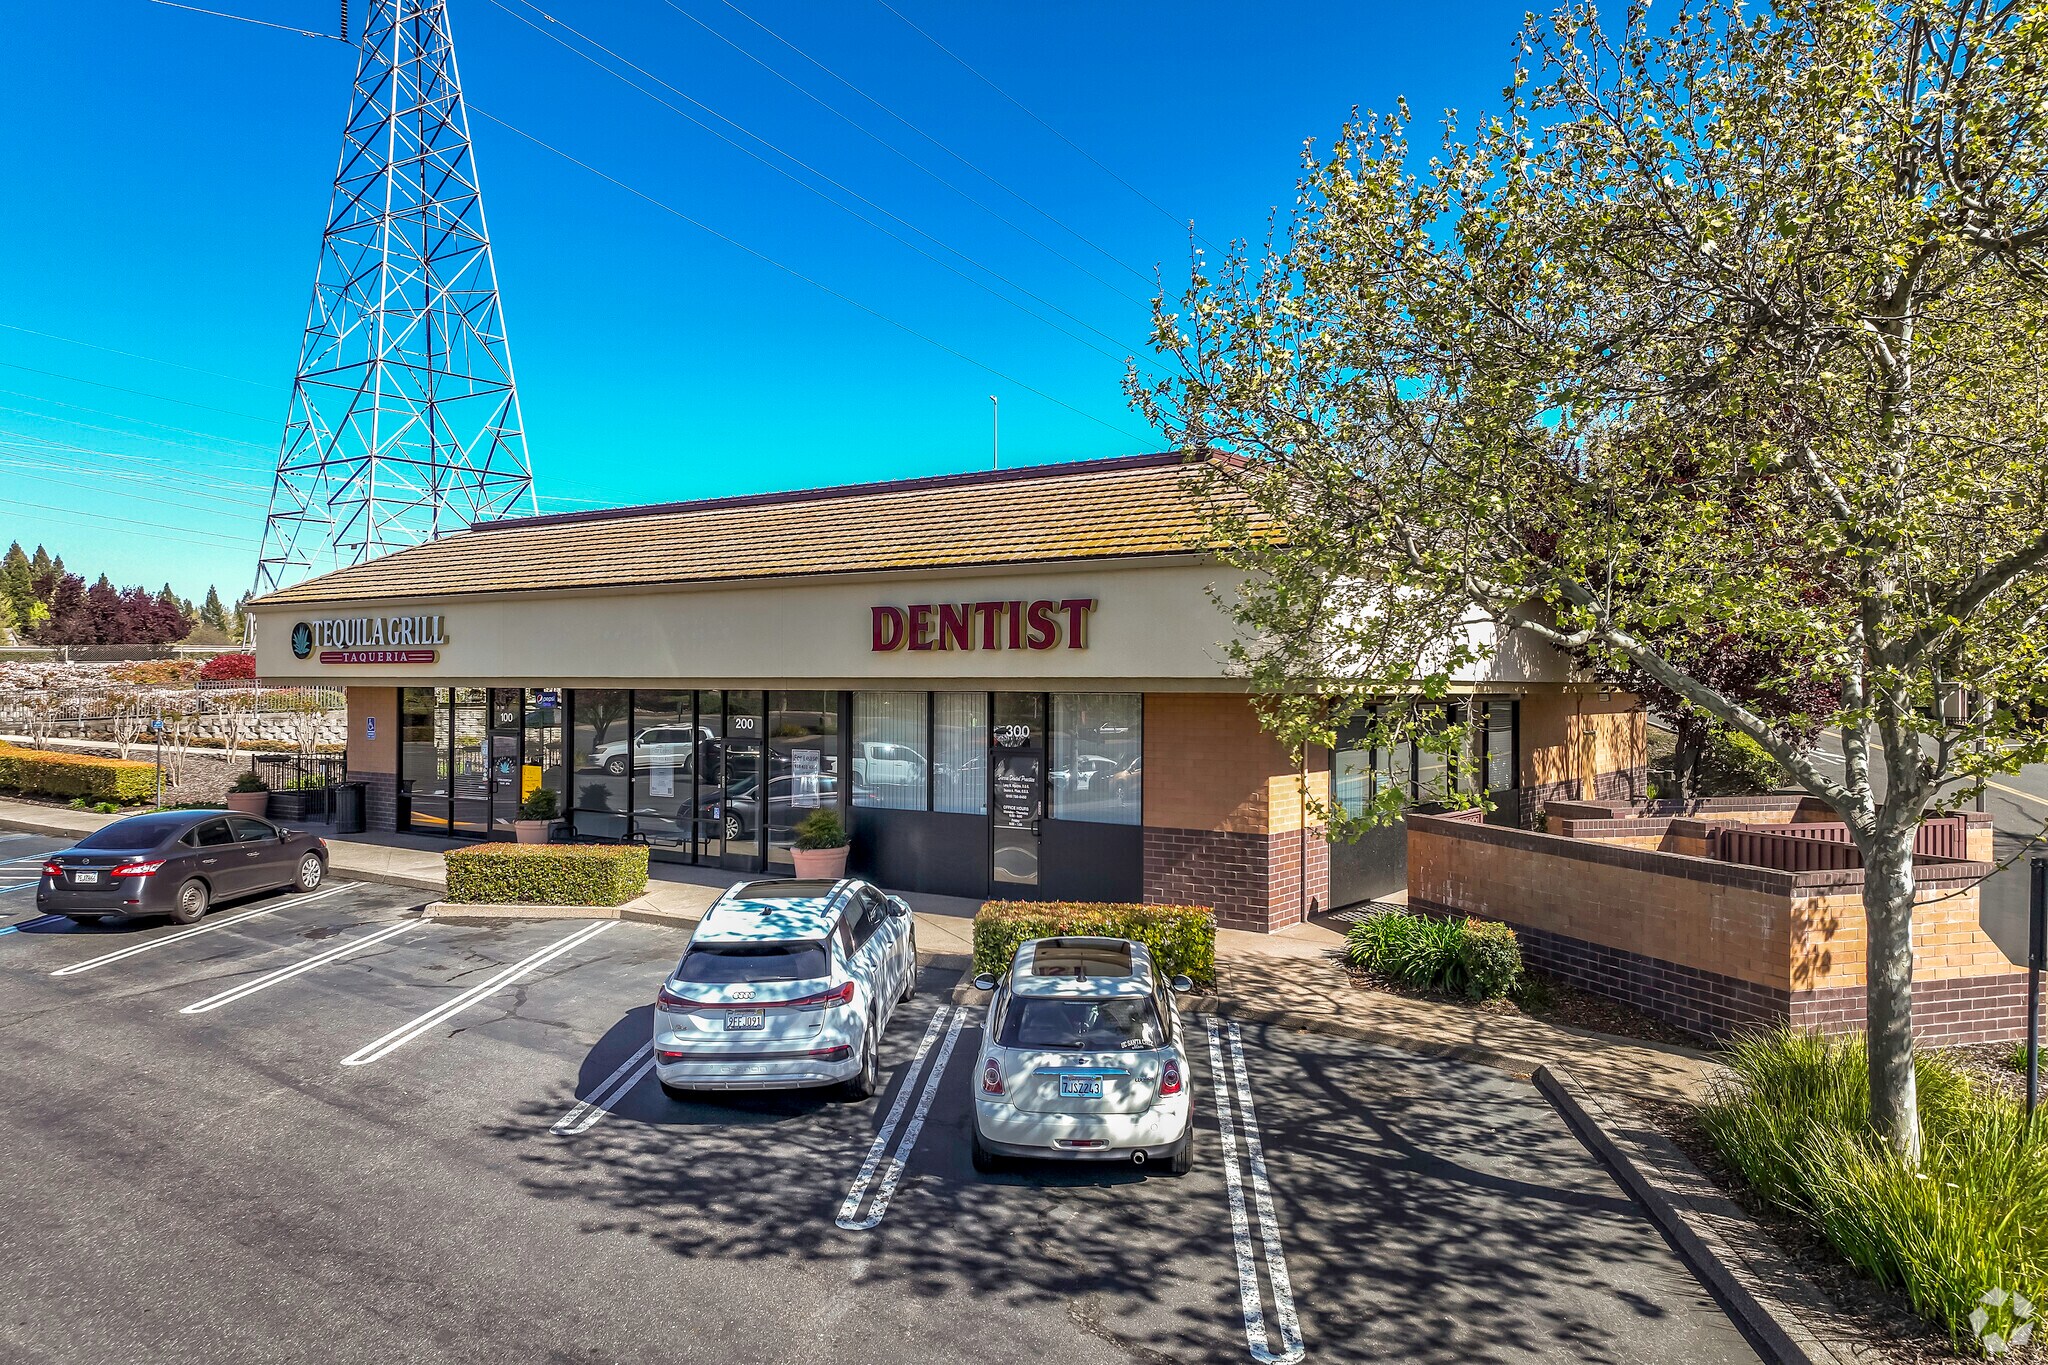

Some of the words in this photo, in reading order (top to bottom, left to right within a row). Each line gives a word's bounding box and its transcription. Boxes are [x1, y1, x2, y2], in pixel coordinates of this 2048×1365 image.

[870, 598, 1096, 651] DENTIST
[312, 618, 386, 649] TEQUILA
[387, 615, 447, 645] GRILL
[342, 652, 409, 663] TAQUERIA
[500, 712, 513, 722] 100
[735, 718, 754, 730] 200
[1005, 725, 1030, 738] 300
[728, 1016, 761, 1027] 9FFJ091
[1127, 1039, 1141, 1047] SANTA
[1062, 1082, 1100, 1095] 7JSZ243
